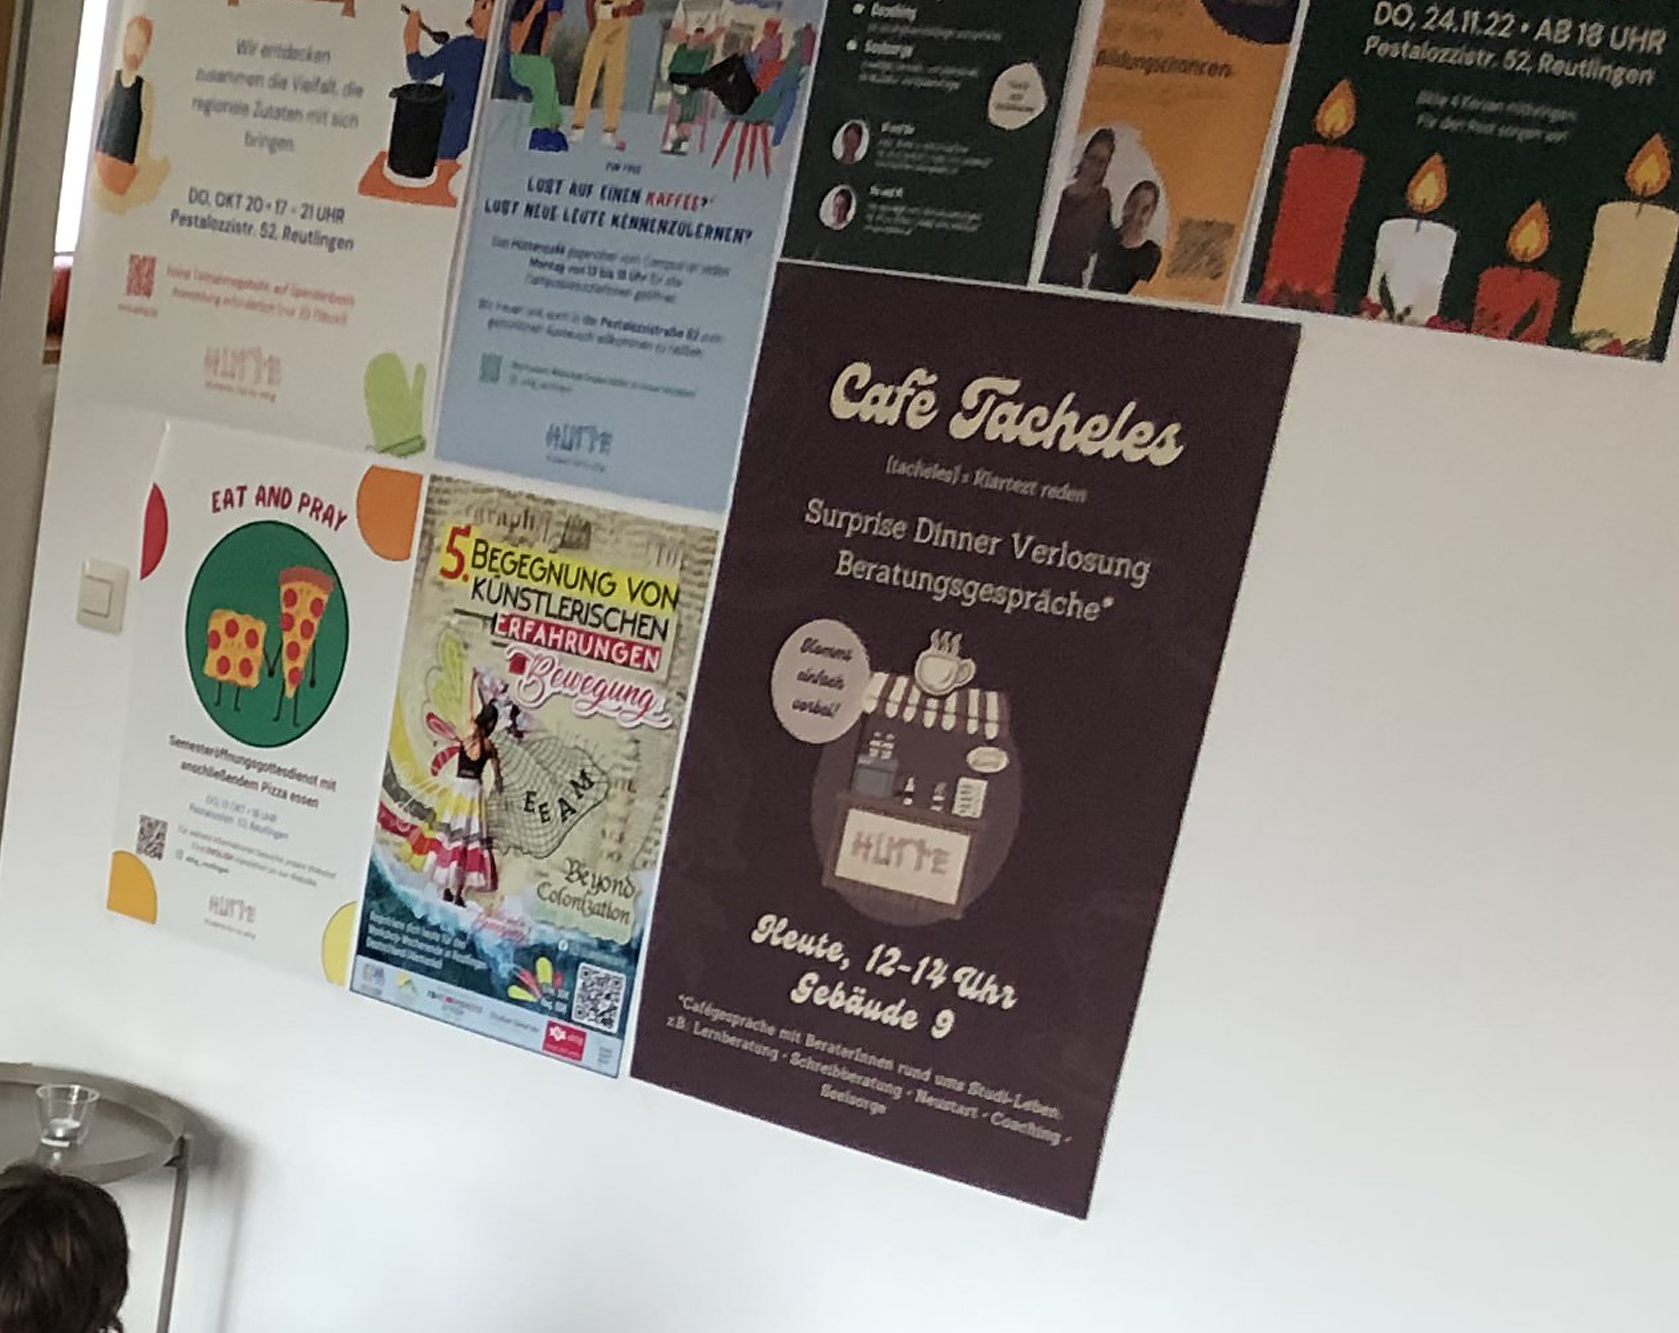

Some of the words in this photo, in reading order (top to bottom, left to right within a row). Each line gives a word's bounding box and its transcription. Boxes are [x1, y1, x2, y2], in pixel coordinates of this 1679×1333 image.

[1422, 5, 1516, 39] 24.11.22
[1534, 18, 1573, 45] AB
[1578, 22, 1605, 48] 18
[1609, 25, 1669, 55] UHR
[268, 73, 288, 91] die
[342, 81, 364, 98] die
[1537, 53, 1657, 89] Reutlingen
[252, 103, 304, 125] Zutaten
[307, 108, 328, 126] mit
[214, 191, 243, 210] OKT
[245, 195, 263, 213] 20
[275, 198, 289, 216] 17
[301, 201, 314, 219] 21
[317, 203, 346, 224] UHR
[483, 197, 520, 217] LUST
[523, 201, 559, 223] NEUE
[562, 208, 606, 229] LEUTE
[527, 176, 566, 196] LUST
[568, 180, 595, 199] AUF
[599, 183, 642, 205] EINEN
[281, 225, 355, 253] Reutlingen
[829, 360, 940, 431] Café
[947, 375, 1187, 467] Tacheles
[211, 484, 248, 514] EAT
[255, 484, 294, 511] AND
[297, 491, 349, 532] PRAY
[1040, 480, 1089, 504] reden
[804, 497, 909, 541] Surprise
[912, 516, 1003, 557] Dinner
[1010, 532, 1153, 590] Verlosung
[439, 522, 470, 583] 5.
[471, 537, 617, 598] BEGEGNUNG
[626, 576, 681, 613] VON
[471, 572, 670, 642] KÜNSTLERISCHEN
[494, 613, 662, 672] ERFAHRUNGEN
[513, 652, 667, 726] Bewegung
[260, 780, 288, 801] Pizza
[289, 791, 320, 809] essen
[319, 777, 338, 793] mit
[564, 856, 637, 899] Beyond
[536, 881, 631, 926] Colonization
[750, 912, 851, 971] Heute,
[865, 943, 950, 990] 12-14
[951, 965, 1020, 1010] Uhr
[790, 971, 920, 1031] Gebäude
[930, 1008, 956, 1040] 9
[778, 1028, 803, 1045] mit
[897, 1062, 933, 1082] rund
[934, 1074, 965, 1093] ums
[692, 1020, 780, 1062] Lernberatung
[914, 1088, 979, 1119] Neustart
[990, 1111, 1062, 1147] Coaching
[820, 1083, 887, 1116] Seelsorge
